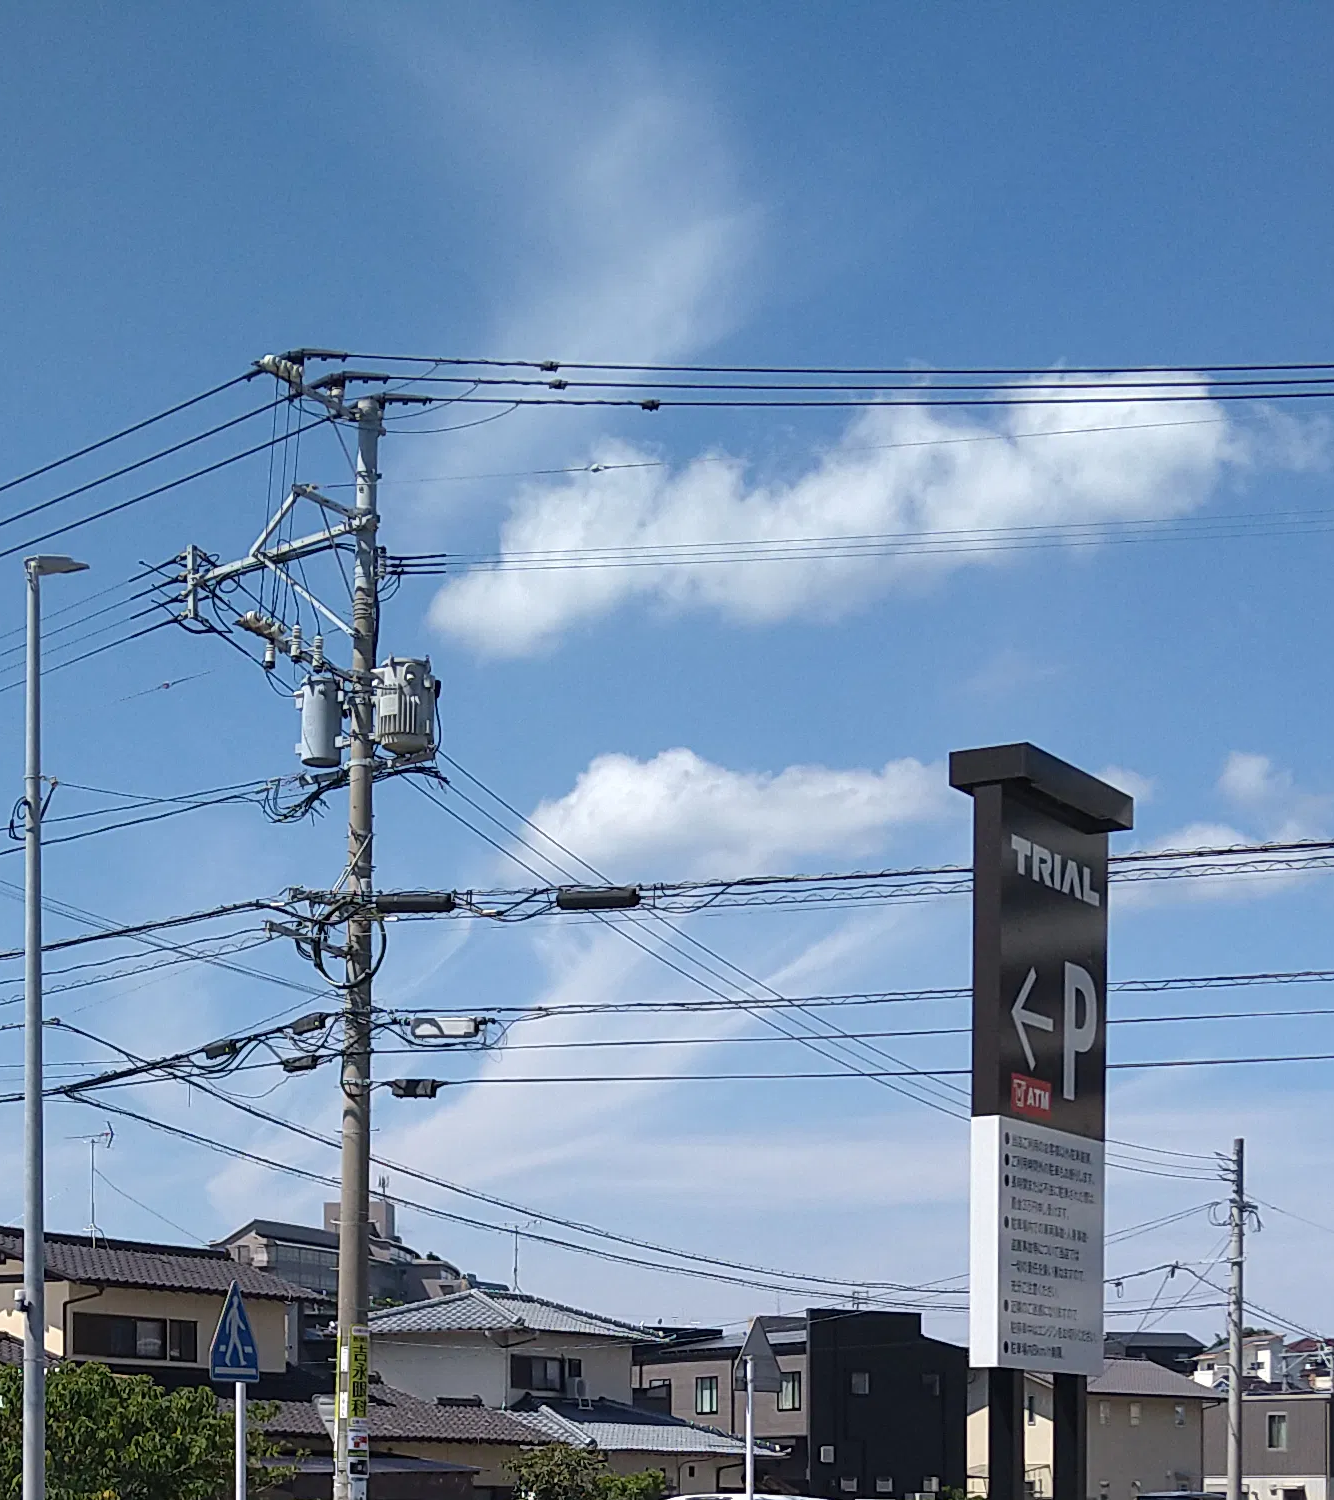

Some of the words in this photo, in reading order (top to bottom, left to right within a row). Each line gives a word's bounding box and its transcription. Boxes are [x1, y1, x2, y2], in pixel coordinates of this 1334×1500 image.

[1011, 834, 1100, 907] TRIAL
[1063, 961, 1098, 1101] P
[1027, 1087, 1049, 1110] ATM
[352, 1344, 368, 1417] 吉永眼科
